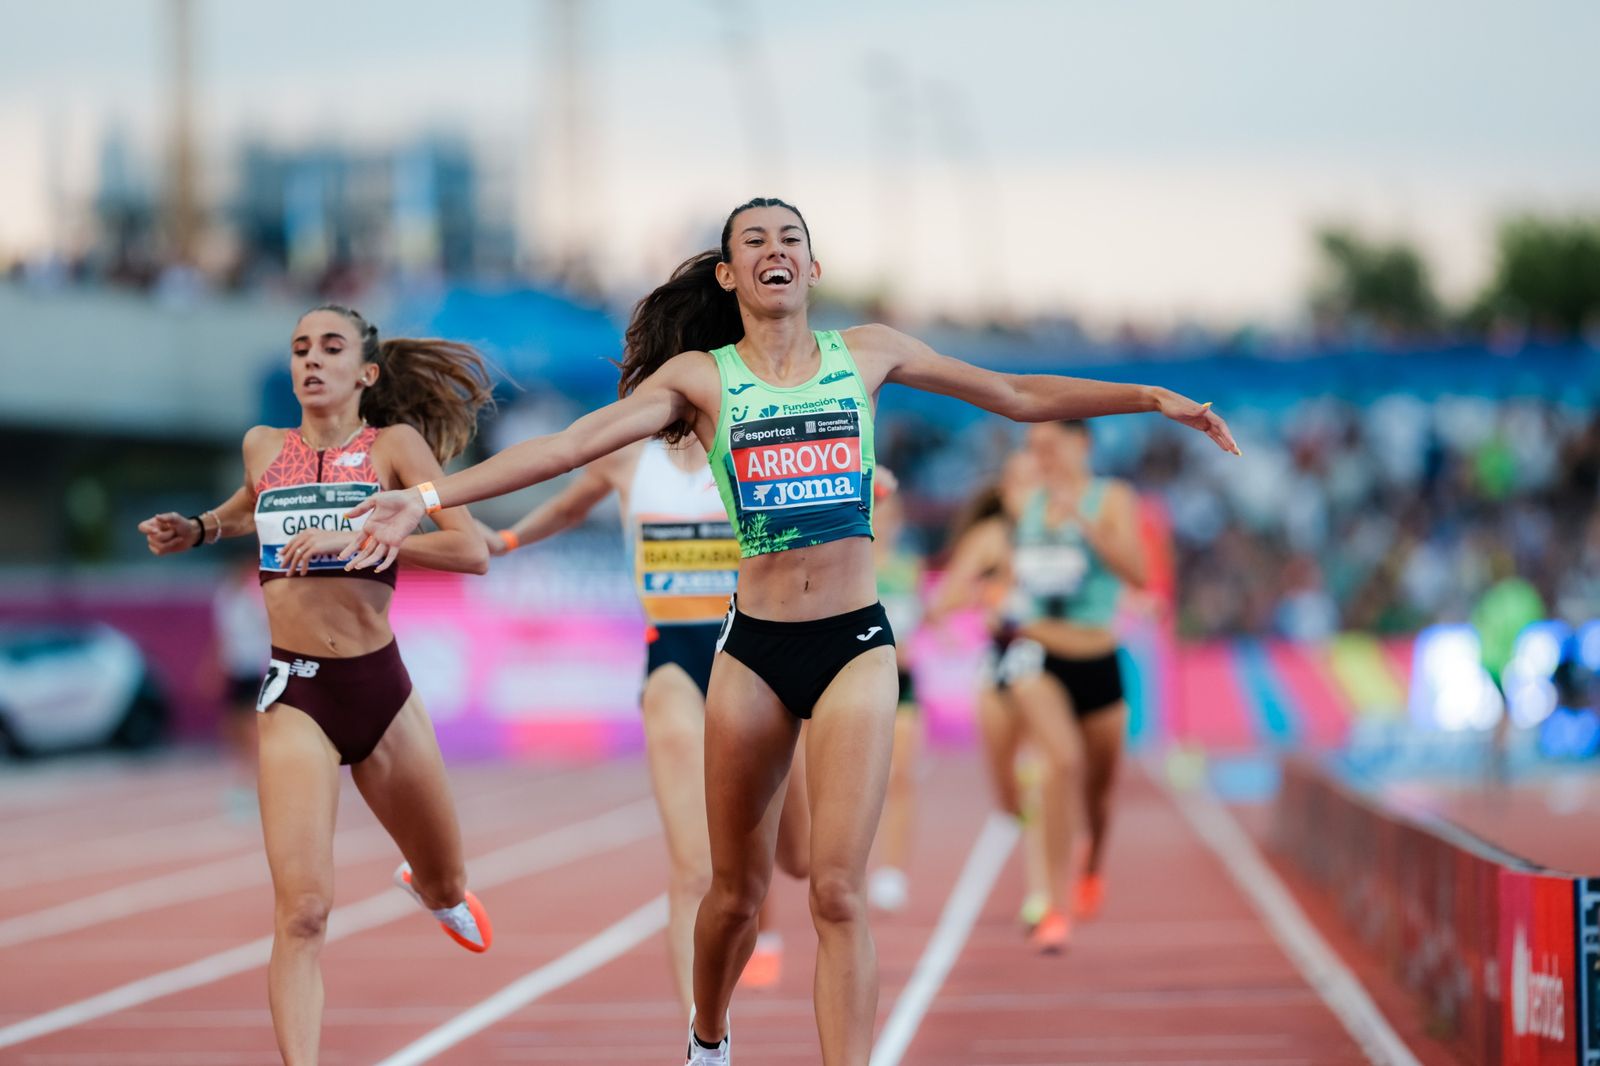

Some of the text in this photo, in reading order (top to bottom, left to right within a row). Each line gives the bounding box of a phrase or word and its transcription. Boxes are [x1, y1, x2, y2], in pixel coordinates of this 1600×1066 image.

[782, 397, 837, 411] Fundación
[817, 419, 849, 427] Generalitat
[827, 425, 855, 433] Catalunya
[745, 426, 796, 441] esportcat
[747, 442, 851, 478] ARROYO
[273, 494, 317, 507] esportcat
[283, 514, 353, 536] GARCIA
